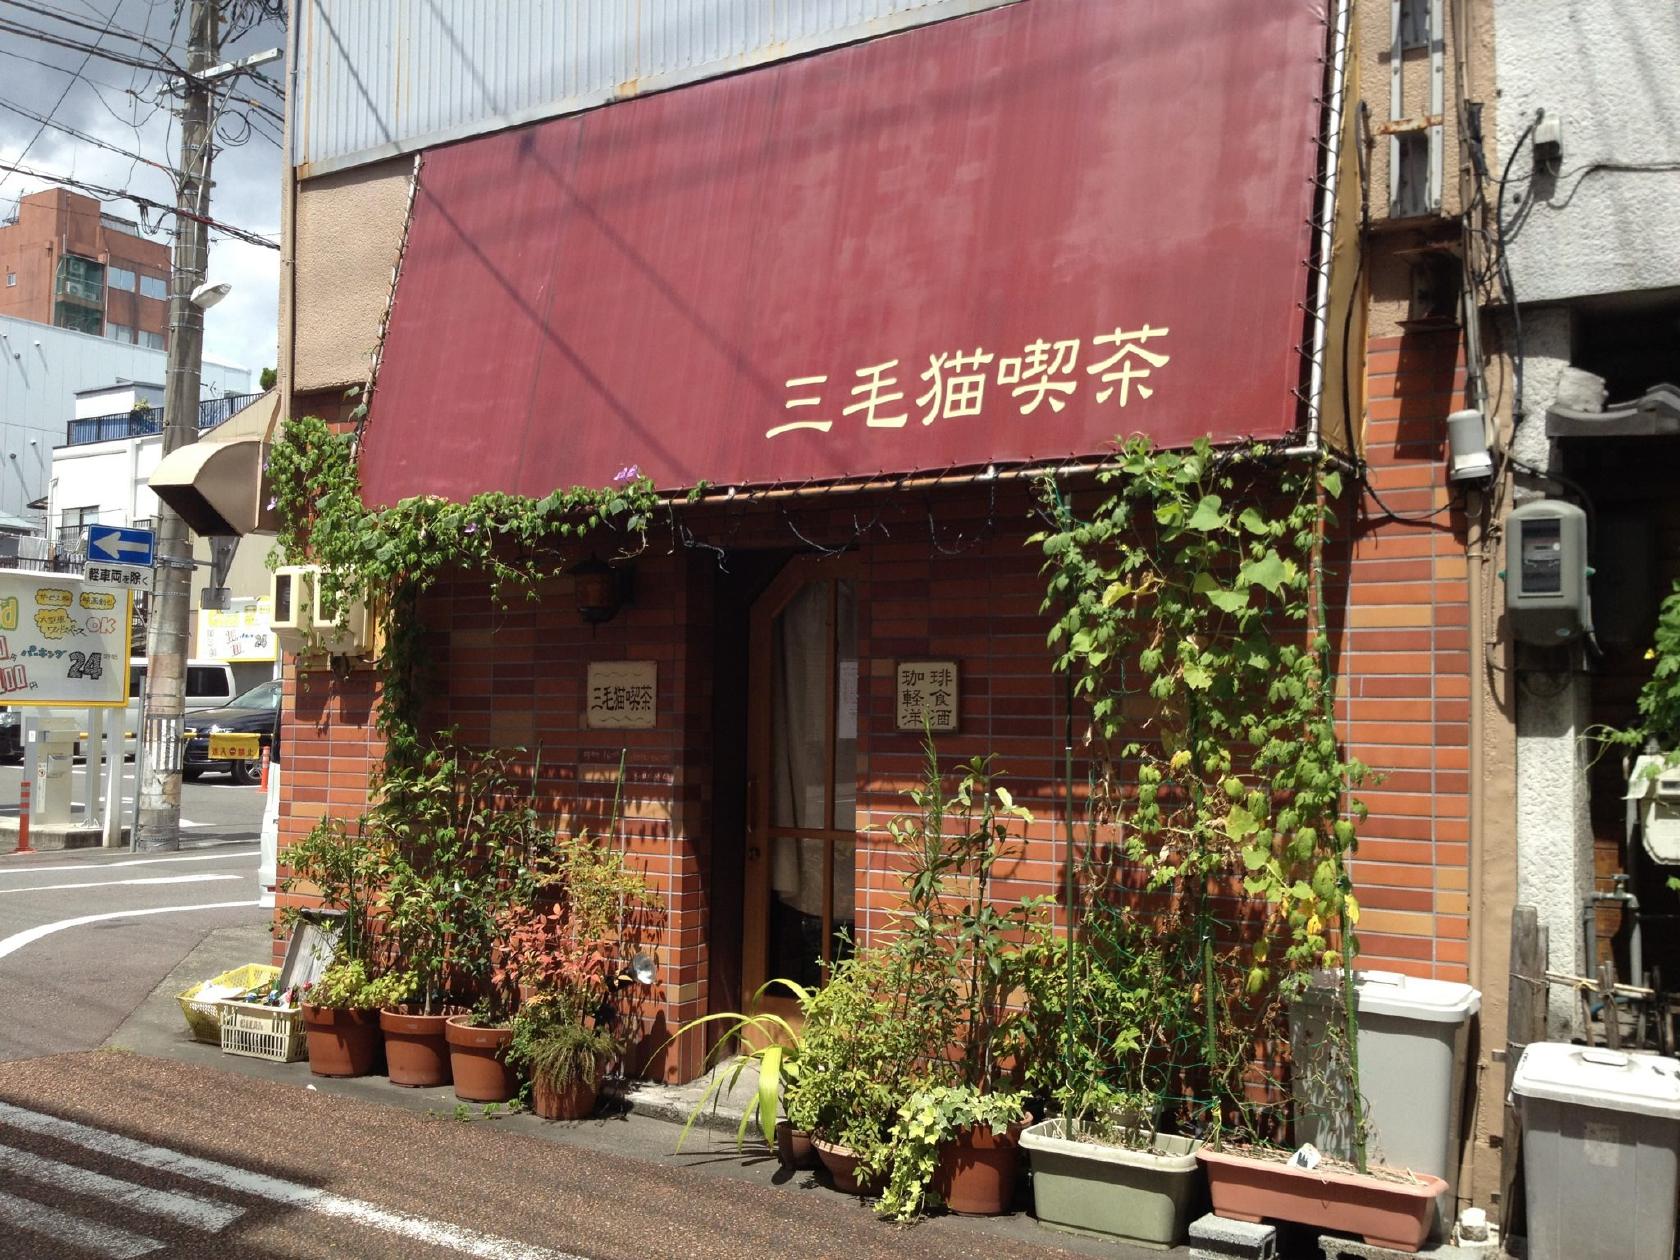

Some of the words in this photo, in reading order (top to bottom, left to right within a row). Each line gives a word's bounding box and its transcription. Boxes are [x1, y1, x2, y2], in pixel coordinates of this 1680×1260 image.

[766, 324, 1170, 438] 三毛猫喫茶
[89, 568, 148, 586] 軽車両を除く
[86, 617, 116, 634] OK
[67, 651, 103, 680] 24
[902, 668, 952, 687] 珈琲
[591, 685, 653, 711] 三毛猫喫茶
[902, 689, 952, 707] 軽食
